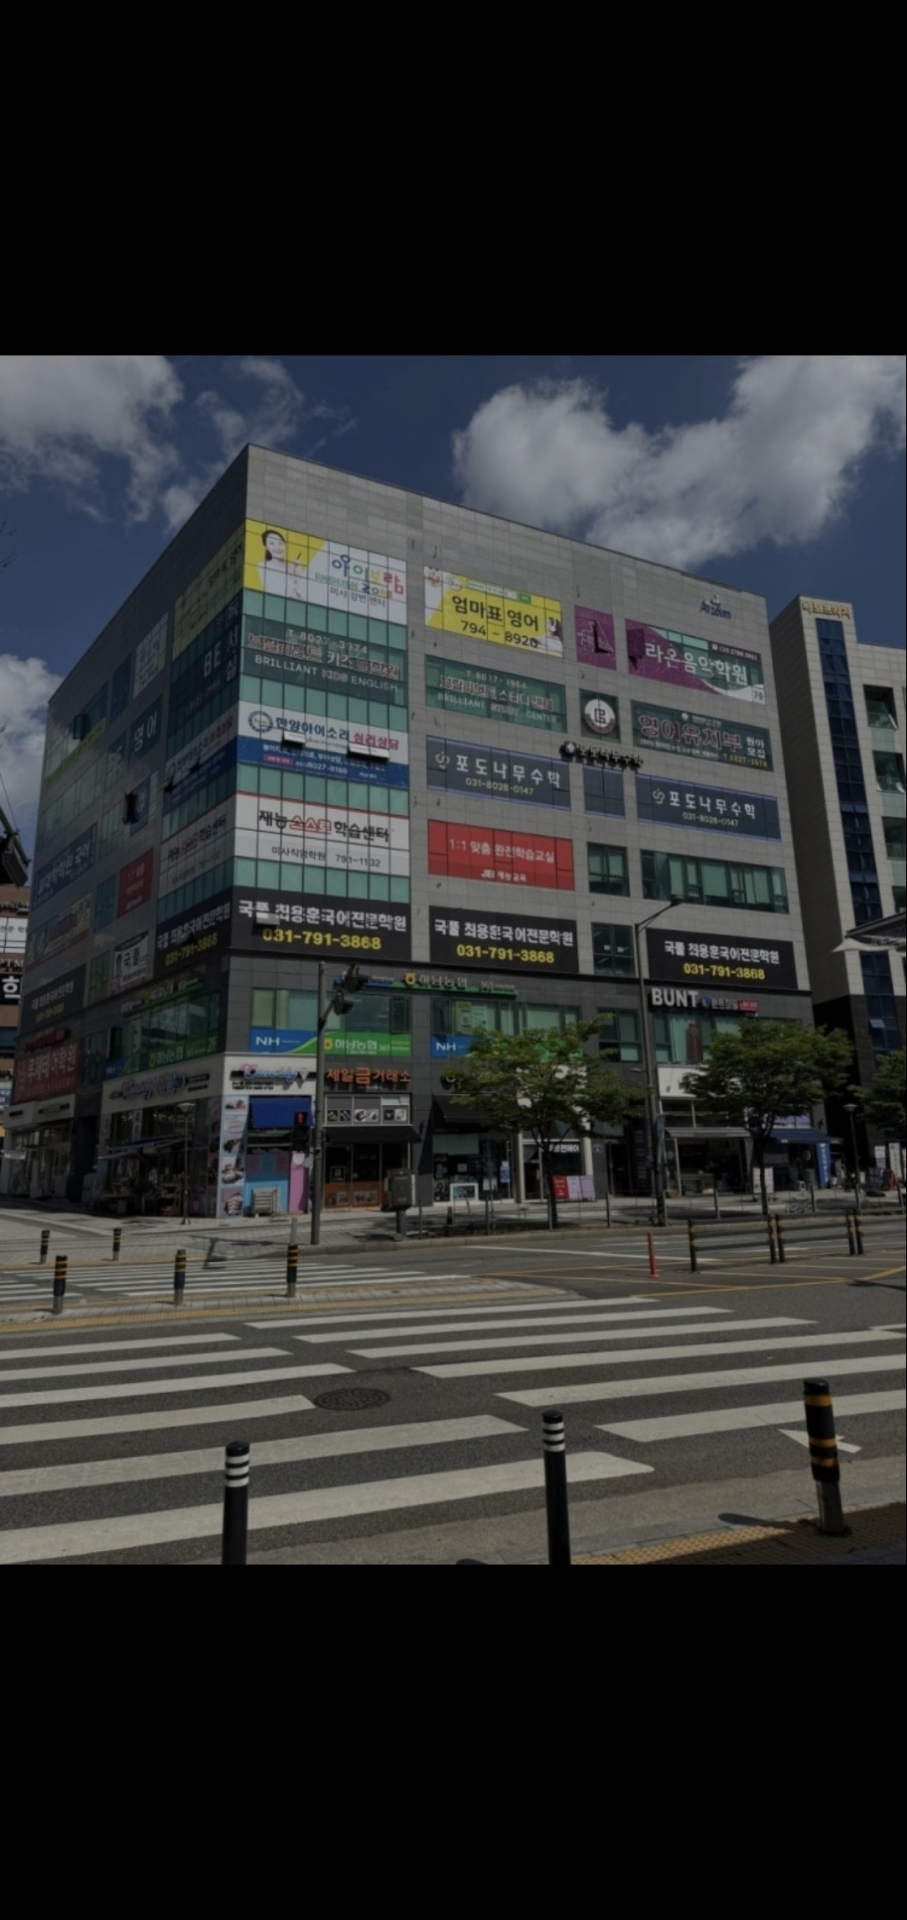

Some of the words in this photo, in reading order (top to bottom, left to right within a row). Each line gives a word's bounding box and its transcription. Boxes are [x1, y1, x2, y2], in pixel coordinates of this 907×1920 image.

[452, 595, 503, 622] 엄마표
[507, 609, 539, 632] 영어
[460, 620, 487, 636] 794
[505, 630, 539, 648] 8920
[326, 651, 354, 668] 키즈
[645, 642, 748, 686] 라온음악학원
[255, 655, 317, 676] BRILLIANT
[351, 676, 399, 692] ENGLISH
[437, 692, 485, 709] BRILLIANT
[499, 689, 530, 706] 스터디
[275, 717, 349, 740] 한양아이소리
[638, 715, 742, 753] 영어유치부
[456, 754, 561, 788] 포도나무수학
[465, 777, 535, 797] 031-8028-0147
[669, 791, 756, 820] 포도나무수학
[449, 838, 467, 852] 1:1
[164, 931, 219, 967] 031-791-3868
[261, 927, 382, 950] 031-791-3868
[456, 943, 556, 964] 031-791-3868
[683, 962, 766, 980] 031-791-3868
[651, 987, 699, 1009] BUNT
[255, 1036, 280, 1047] NH
[436, 1042, 457, 1051] NH
[325, 1066, 412, 1085] 제일금거래소
